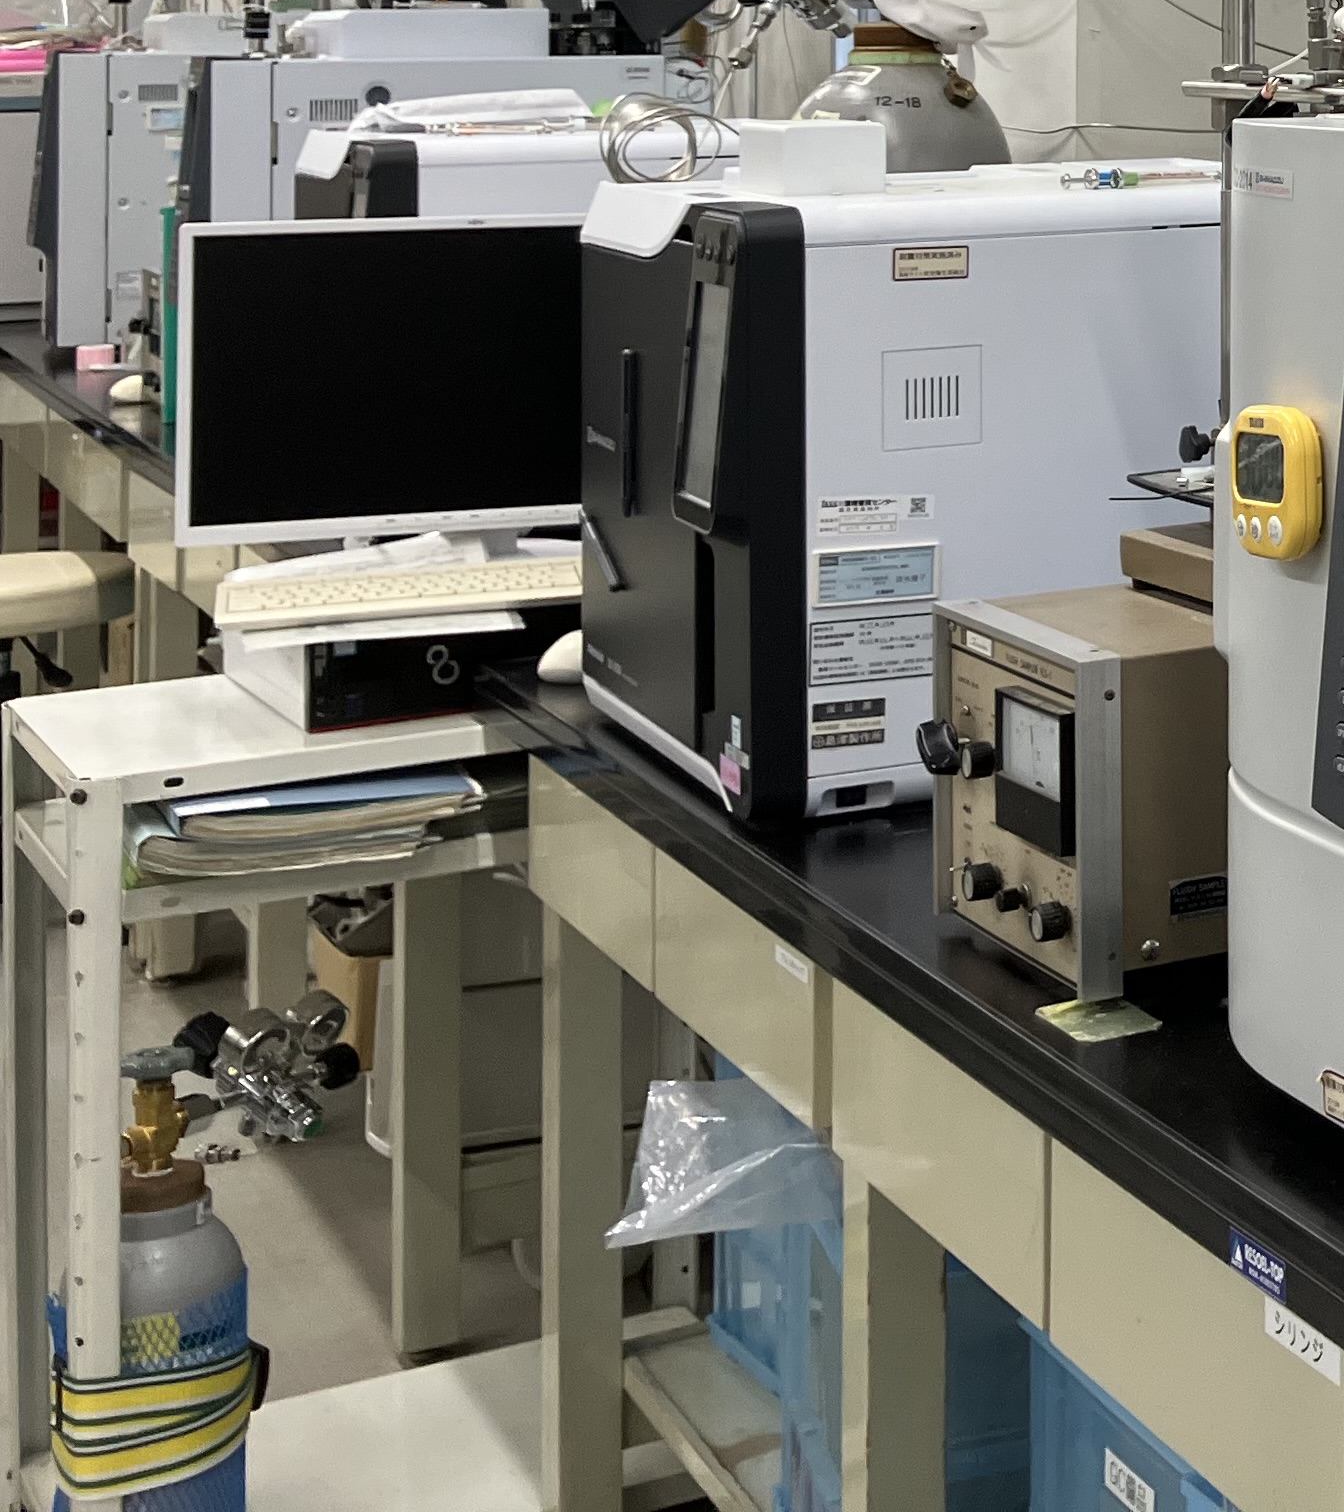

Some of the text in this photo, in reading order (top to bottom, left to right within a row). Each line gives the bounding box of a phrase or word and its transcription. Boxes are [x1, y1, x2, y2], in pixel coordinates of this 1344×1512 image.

[874, 95, 922, 108] 12-18
[1274, 1310, 1324, 1363] シリンジ
